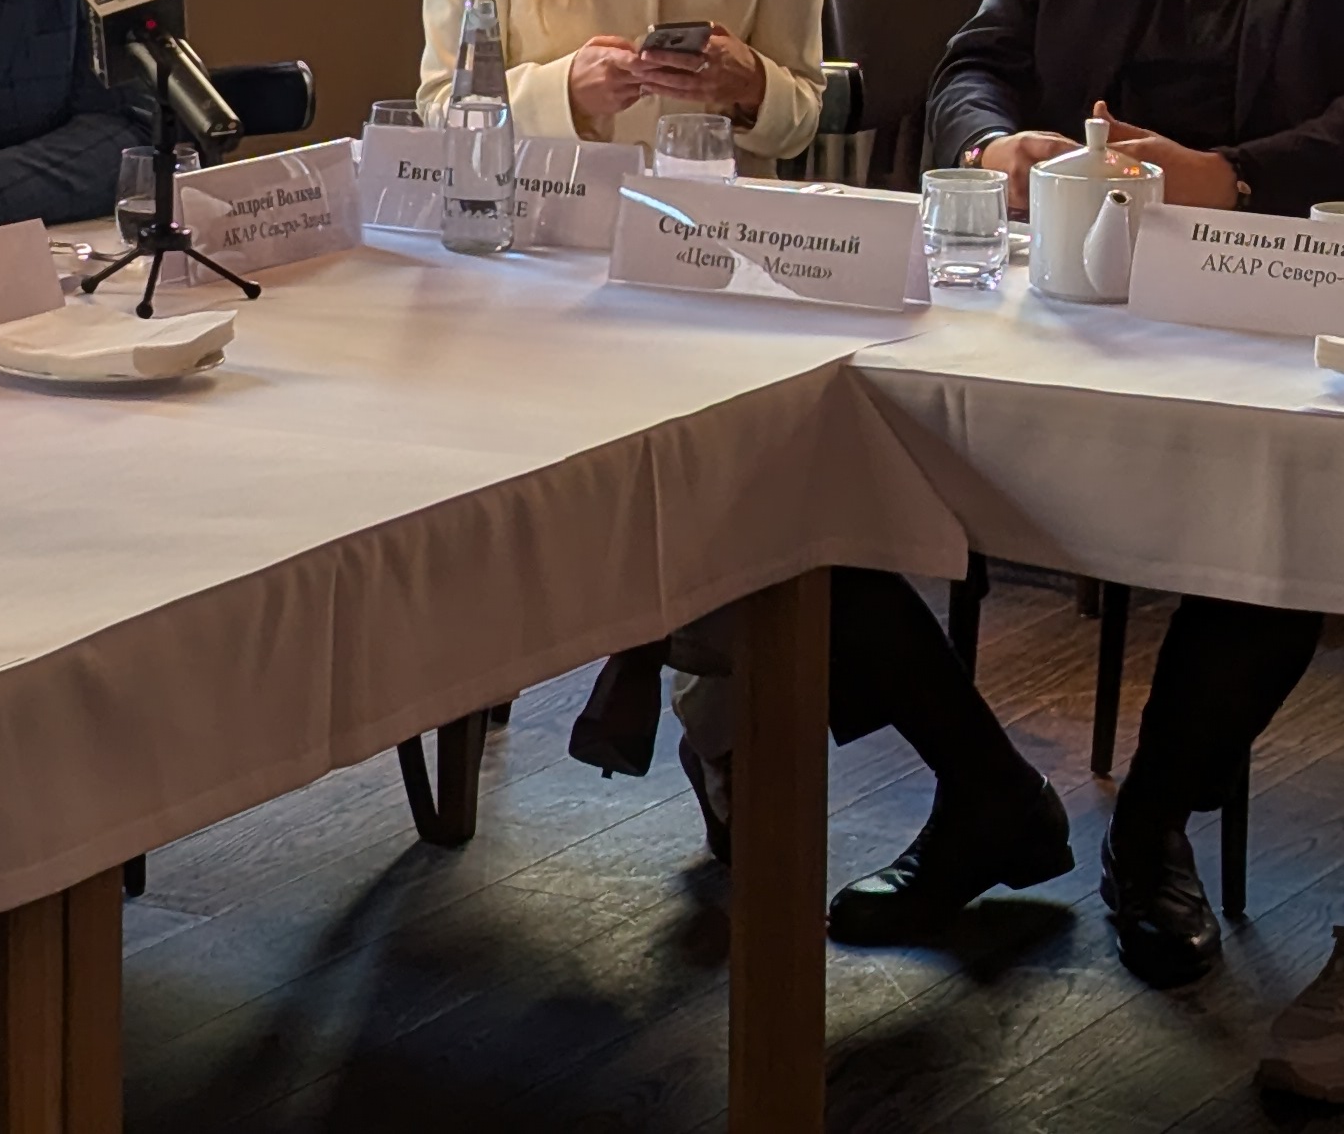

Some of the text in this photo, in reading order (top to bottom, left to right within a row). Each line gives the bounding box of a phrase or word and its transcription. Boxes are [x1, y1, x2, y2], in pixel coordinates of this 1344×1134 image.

[222, 223, 258, 248] АКАР
[658, 214, 862, 255] Сергей Загородный
[1190, 222, 1287, 251] Наталья
[762, 254, 833, 280] Медиа»
[1200, 252, 1264, 276] АКАР
